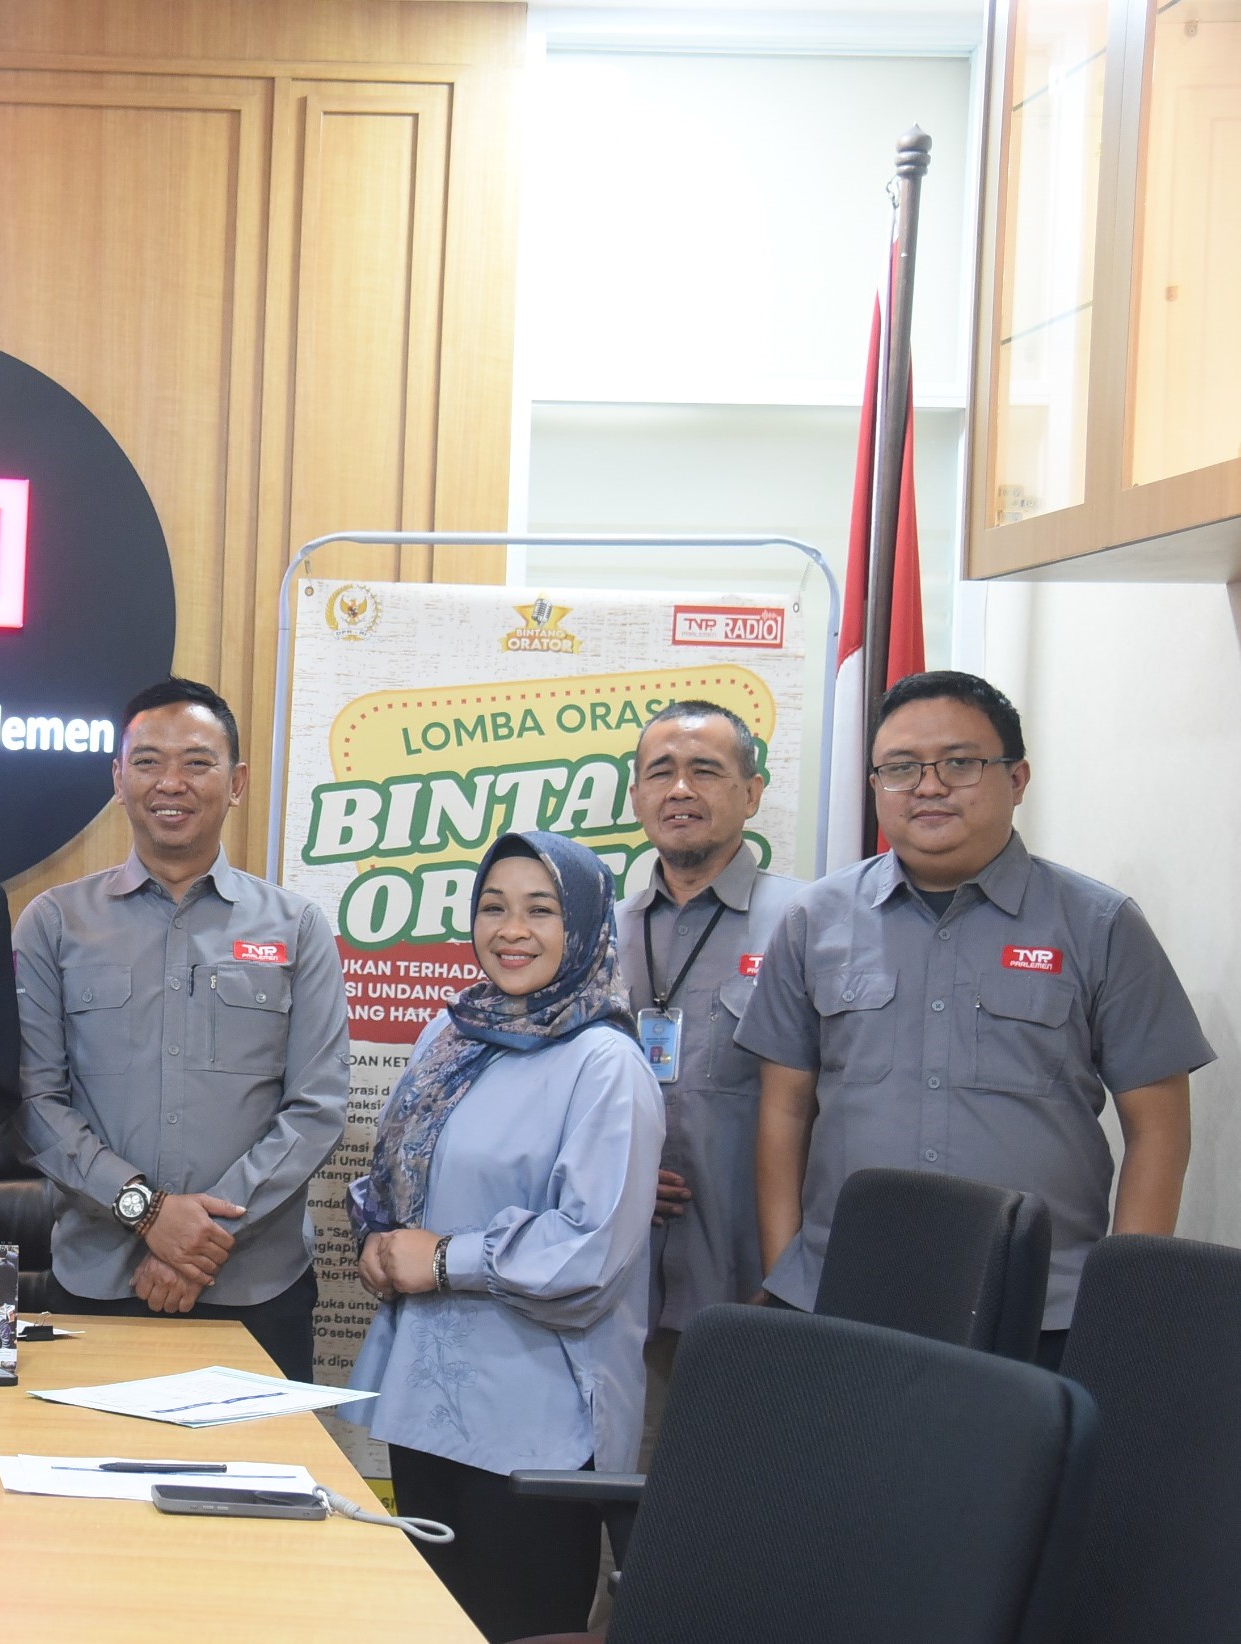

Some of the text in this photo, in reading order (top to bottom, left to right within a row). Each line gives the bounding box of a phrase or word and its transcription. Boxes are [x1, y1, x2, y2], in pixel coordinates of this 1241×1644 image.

[516, 628, 566, 639] BINTANG
[724, 618, 777, 640] RADIO
[508, 637, 573, 651] ORATOR
[401, 708, 545, 756] LOMBA
[396, 961, 490, 980] TERHADA
[1009, 960, 1053, 971] PARLEMEN
[344, 982, 363, 998] SI
[346, 1004, 385, 1021] ANG
[389, 1006, 432, 1023] HAK
[382, 1056, 410, 1068] KET
[347, 1113, 379, 1127] deng
[340, 1156, 374, 1167] Unda
[307, 1198, 346, 1209] endaf
[314, 1225, 324, 1237] is
[340, 1257, 359, 1267] Pro
[322, 1270, 339, 1280] No
[348, 1300, 378, 1311] untu
[315, 1314, 331, 1325] pa
[330, 1327, 366, 1339] sebel
